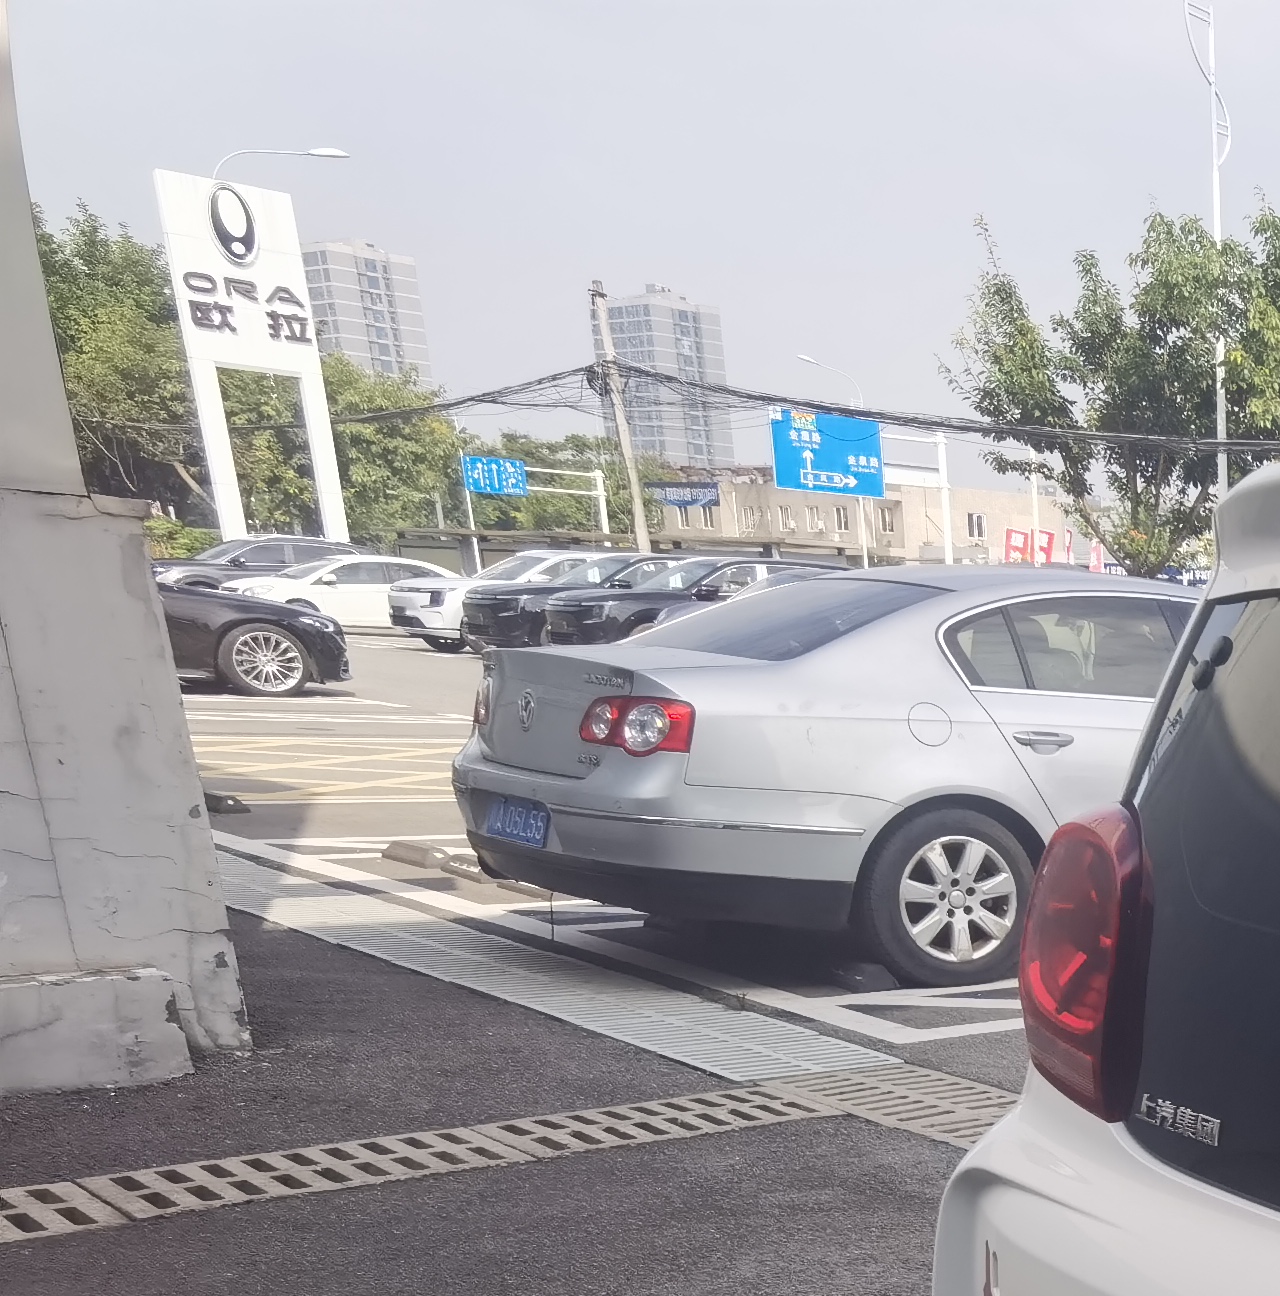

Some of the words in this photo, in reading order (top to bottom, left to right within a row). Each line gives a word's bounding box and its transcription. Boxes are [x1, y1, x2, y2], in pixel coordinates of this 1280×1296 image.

[183, 271, 306, 308] ORA
[188, 299, 313, 344] 欧拉
[1135, 1093, 1221, 1147] 上汽集团
